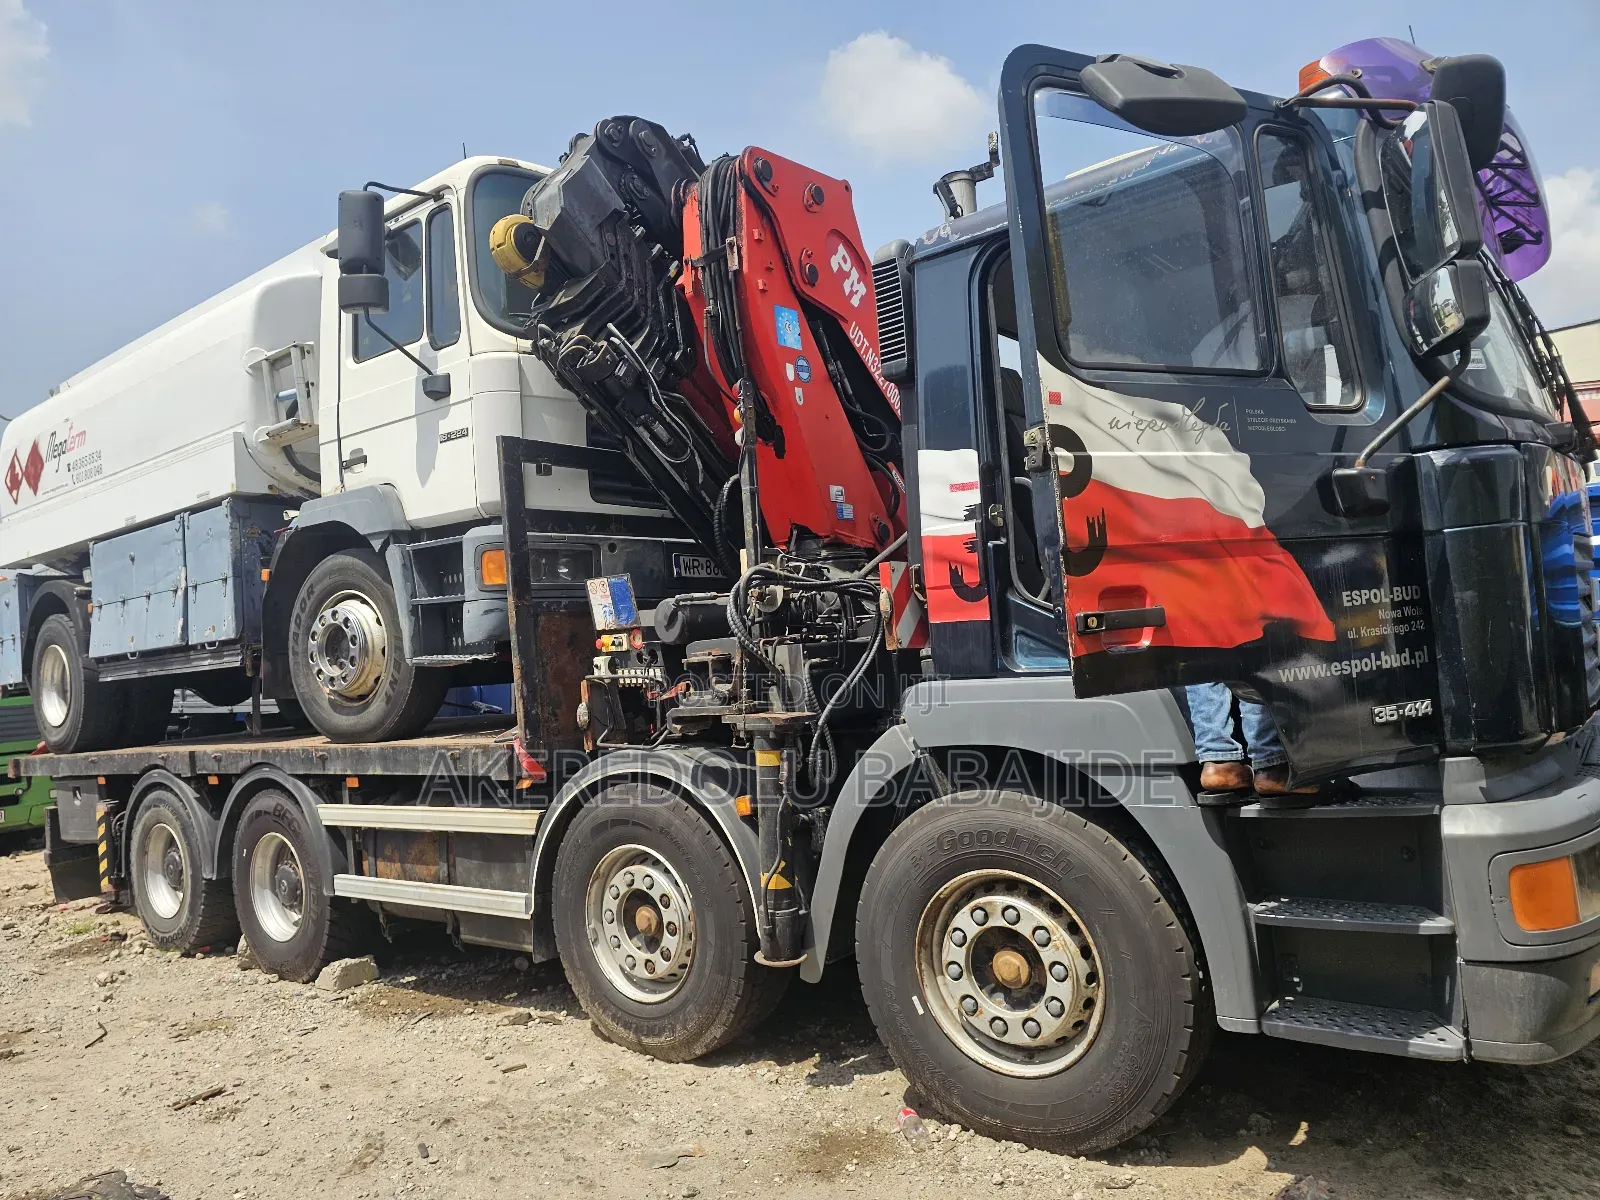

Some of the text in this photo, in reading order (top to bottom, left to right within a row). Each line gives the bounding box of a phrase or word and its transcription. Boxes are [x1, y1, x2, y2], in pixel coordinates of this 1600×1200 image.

[830, 242, 867, 307] PM
[683, 558, 701, 575] WR
[1341, 585, 1421, 607] ESPOL-BUD
[1378, 605, 1423, 620] Nowa Wola
[1347, 619, 1426, 639] ul. Krasickiego 242
[1278, 645, 1429, 683] www.espol-bud.pl
